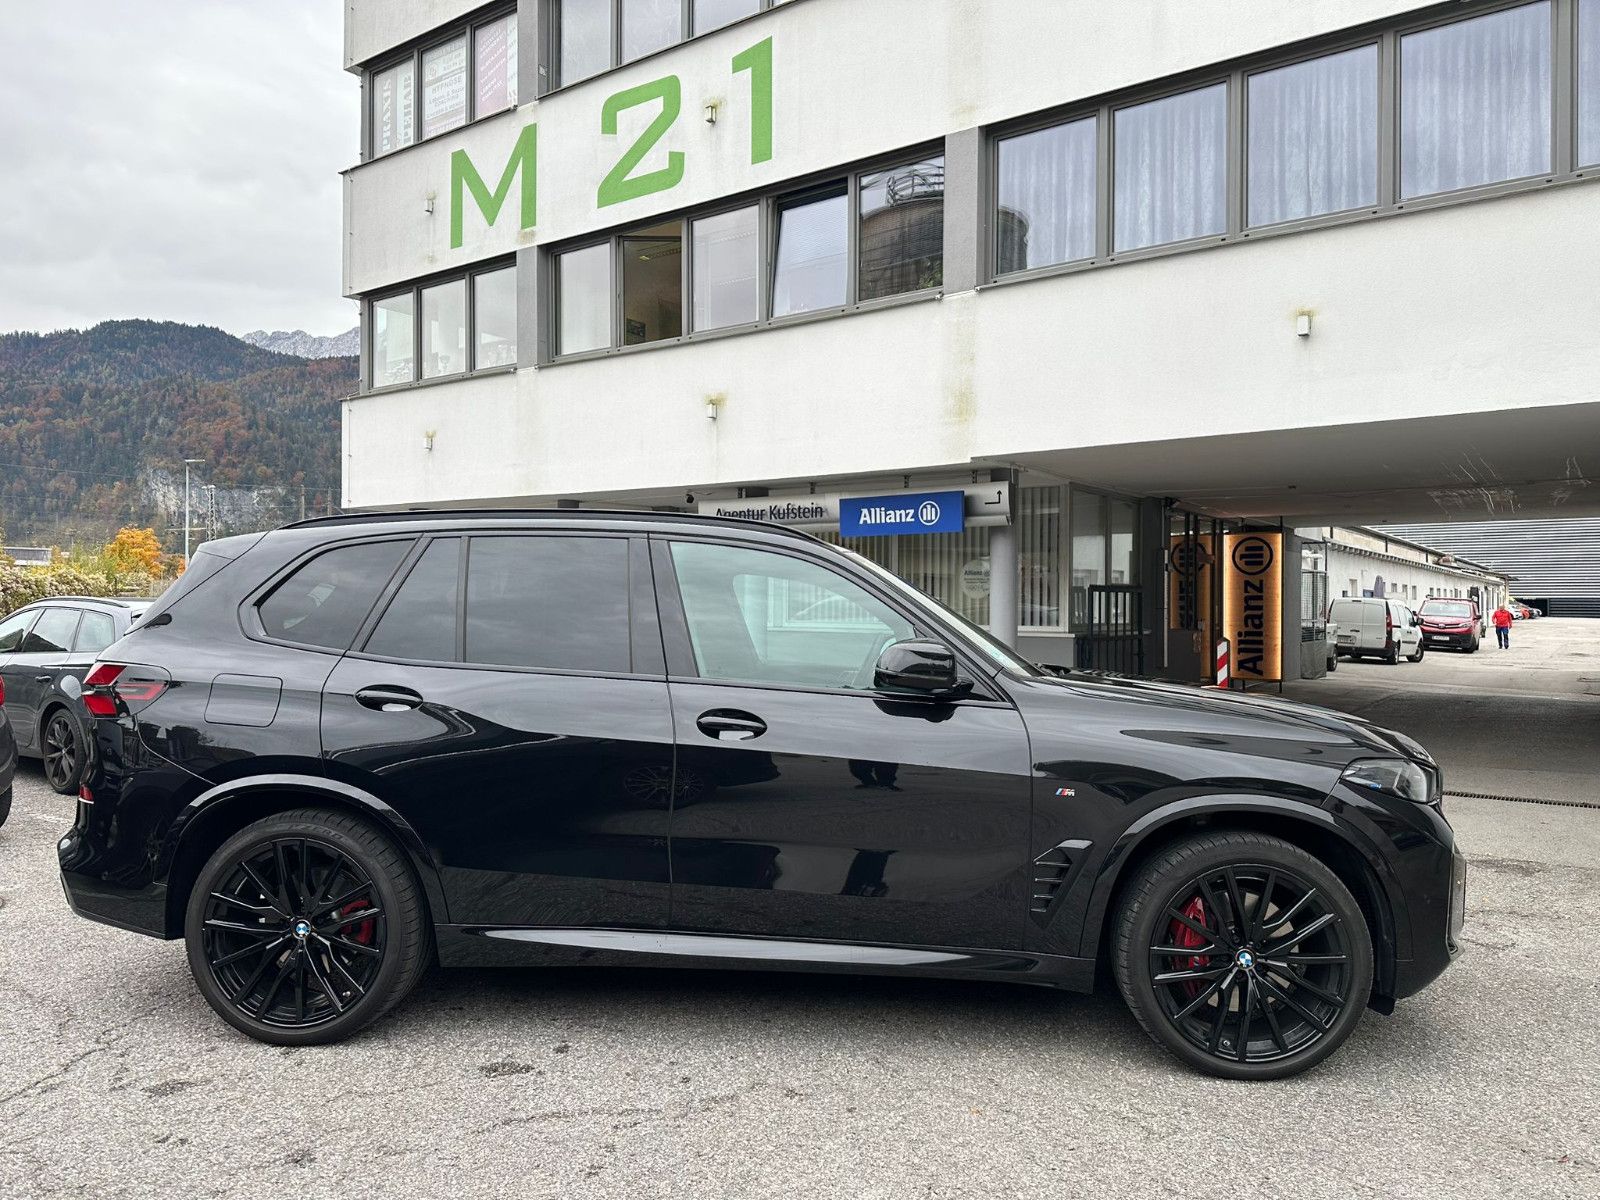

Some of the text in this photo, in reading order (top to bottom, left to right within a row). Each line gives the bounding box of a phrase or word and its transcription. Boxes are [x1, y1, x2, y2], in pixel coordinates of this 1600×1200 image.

[382, 79, 391, 152] PRAXIS
[450, 122, 537, 249] M
[769, 502, 824, 520] Kufstein
[859, 506, 915, 525] Allianz
[1237, 579, 1264, 677] Allianz
